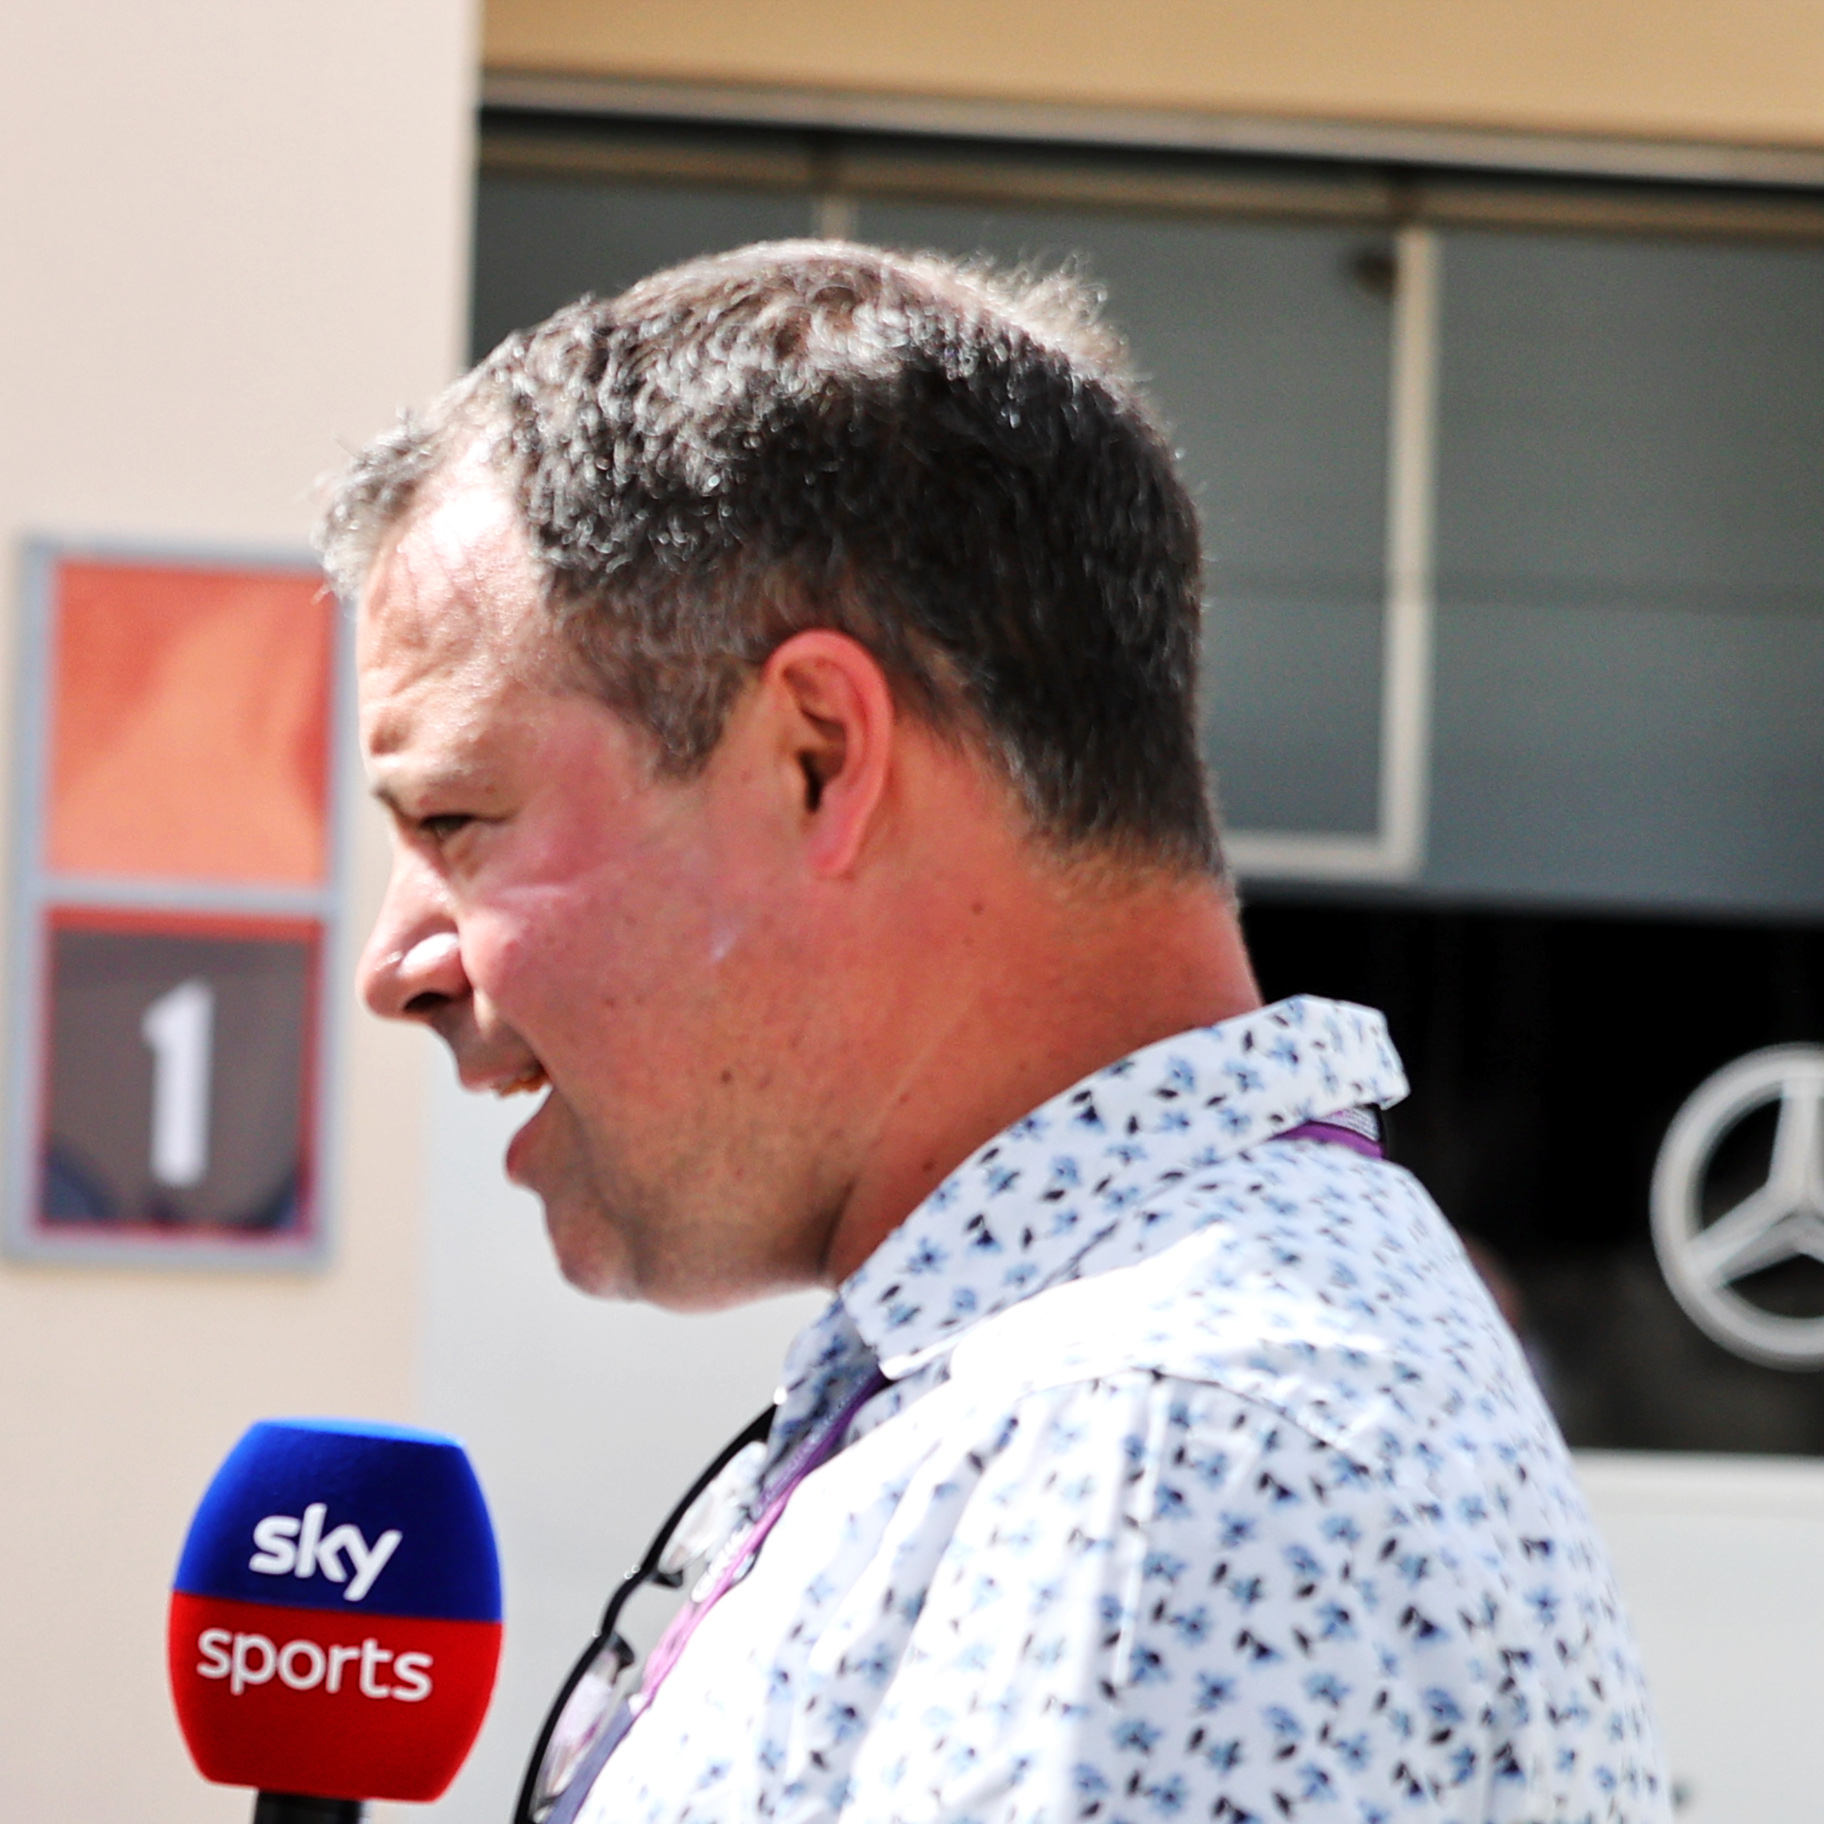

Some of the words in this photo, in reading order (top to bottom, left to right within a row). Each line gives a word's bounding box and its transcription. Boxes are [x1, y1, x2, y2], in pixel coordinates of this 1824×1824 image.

[142, 978, 215, 1188] 1
[249, 1502, 402, 1601] sky
[195, 1628, 434, 1703] sports
